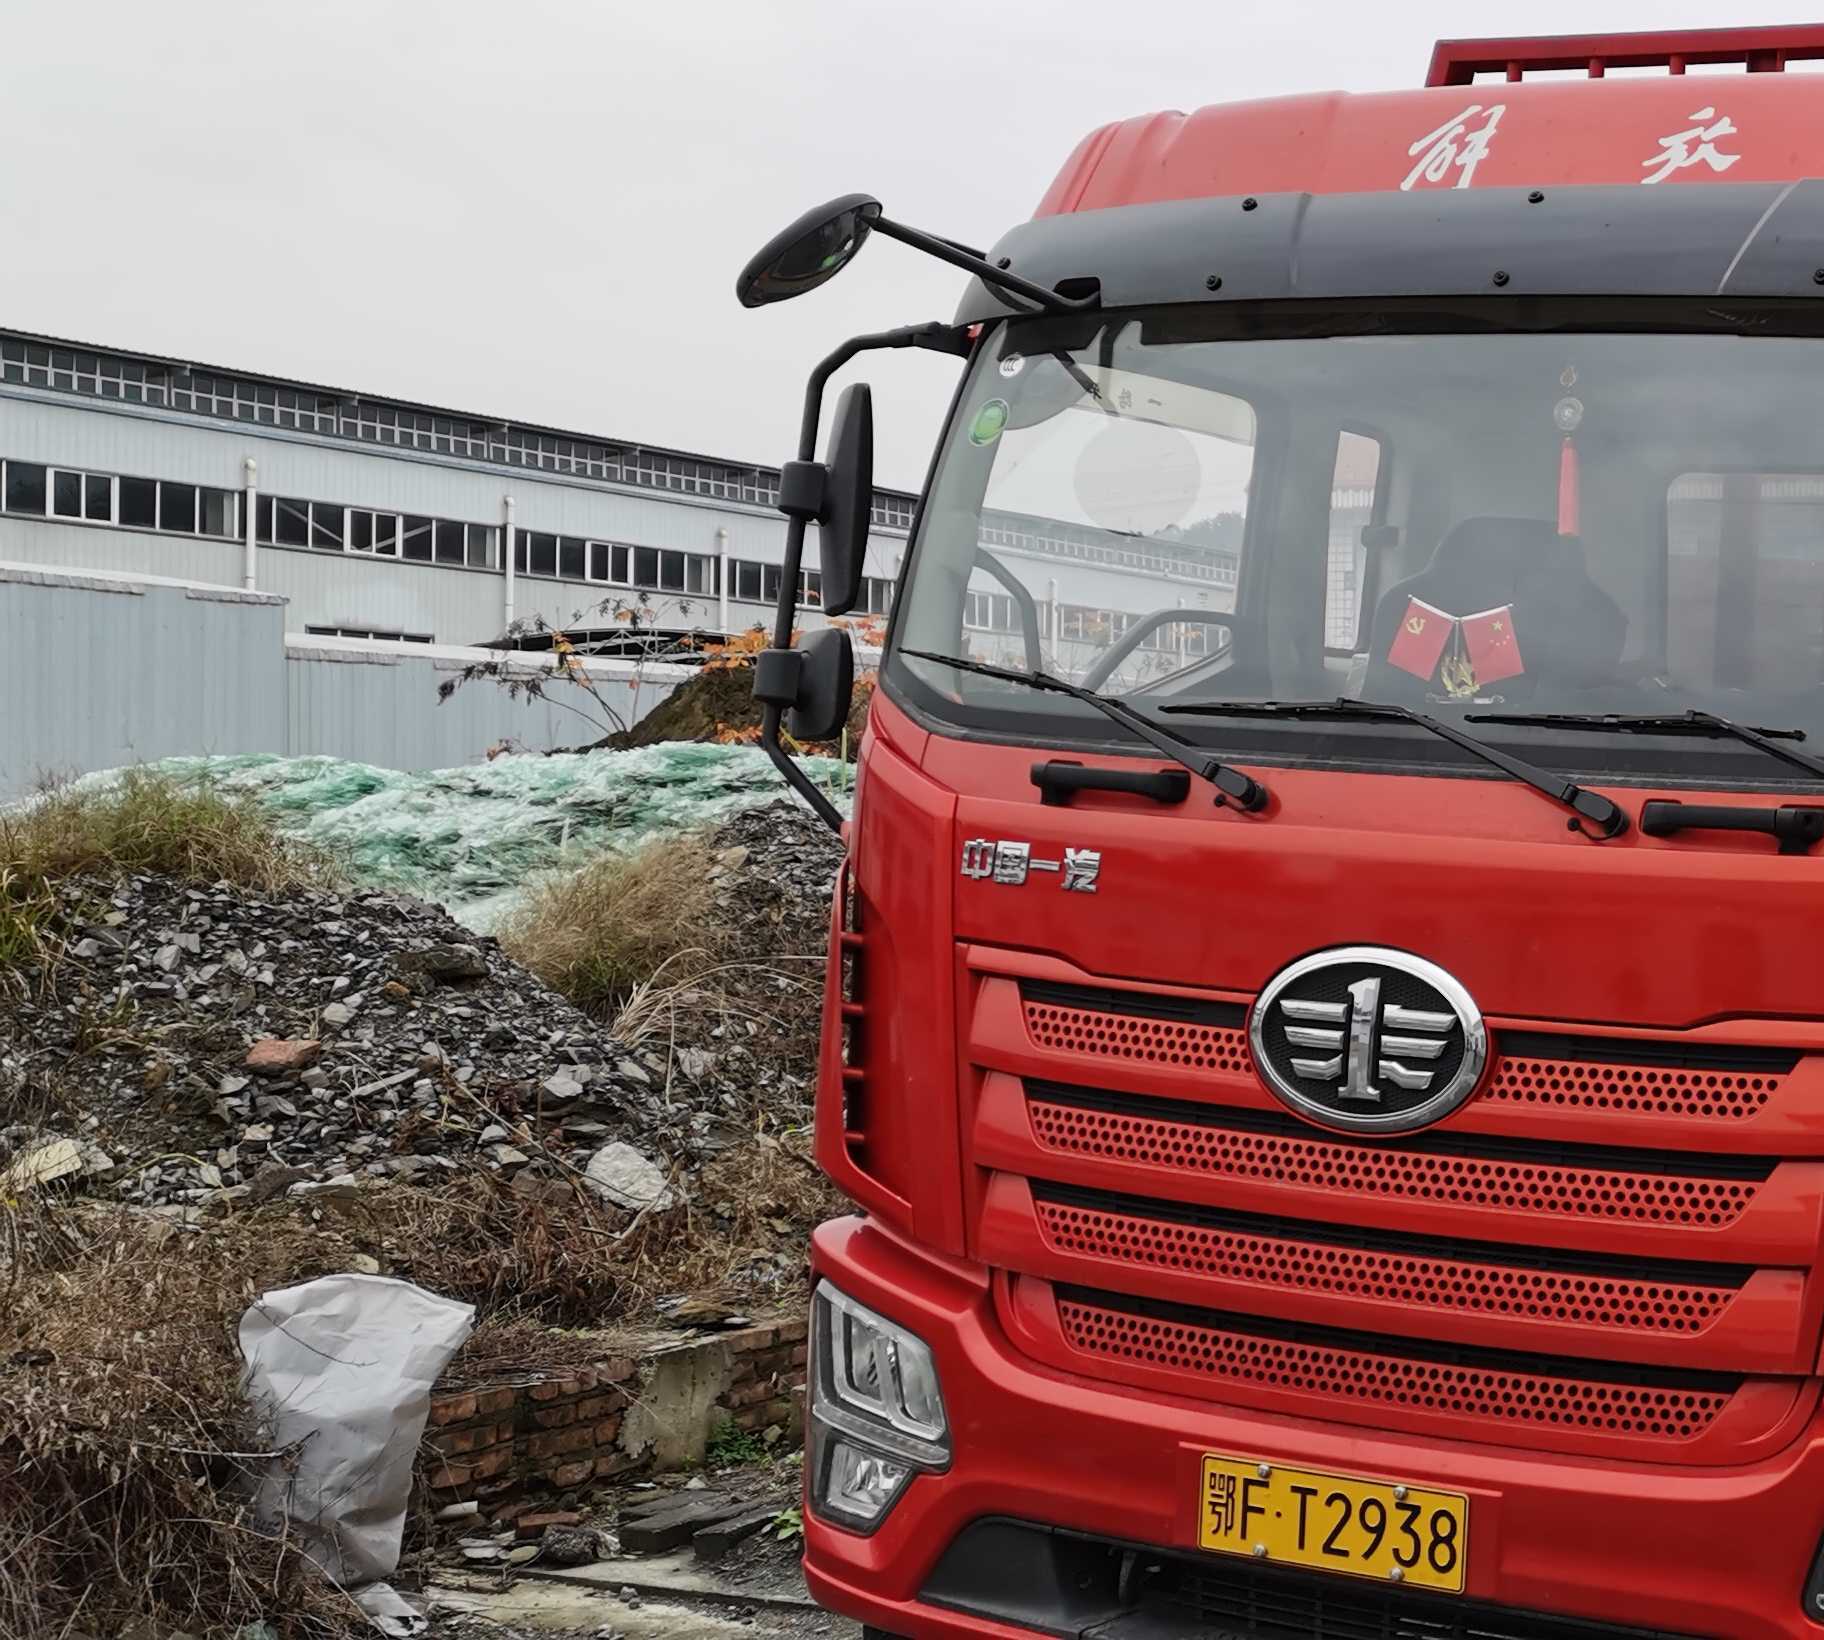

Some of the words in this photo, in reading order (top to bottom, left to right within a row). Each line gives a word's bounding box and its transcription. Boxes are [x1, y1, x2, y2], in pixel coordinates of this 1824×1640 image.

[1400, 104, 1741, 191] 解放
[960, 838, 1100, 893] 中国一汽
[1208, 1472, 1457, 1573] 鄂F·T2938
